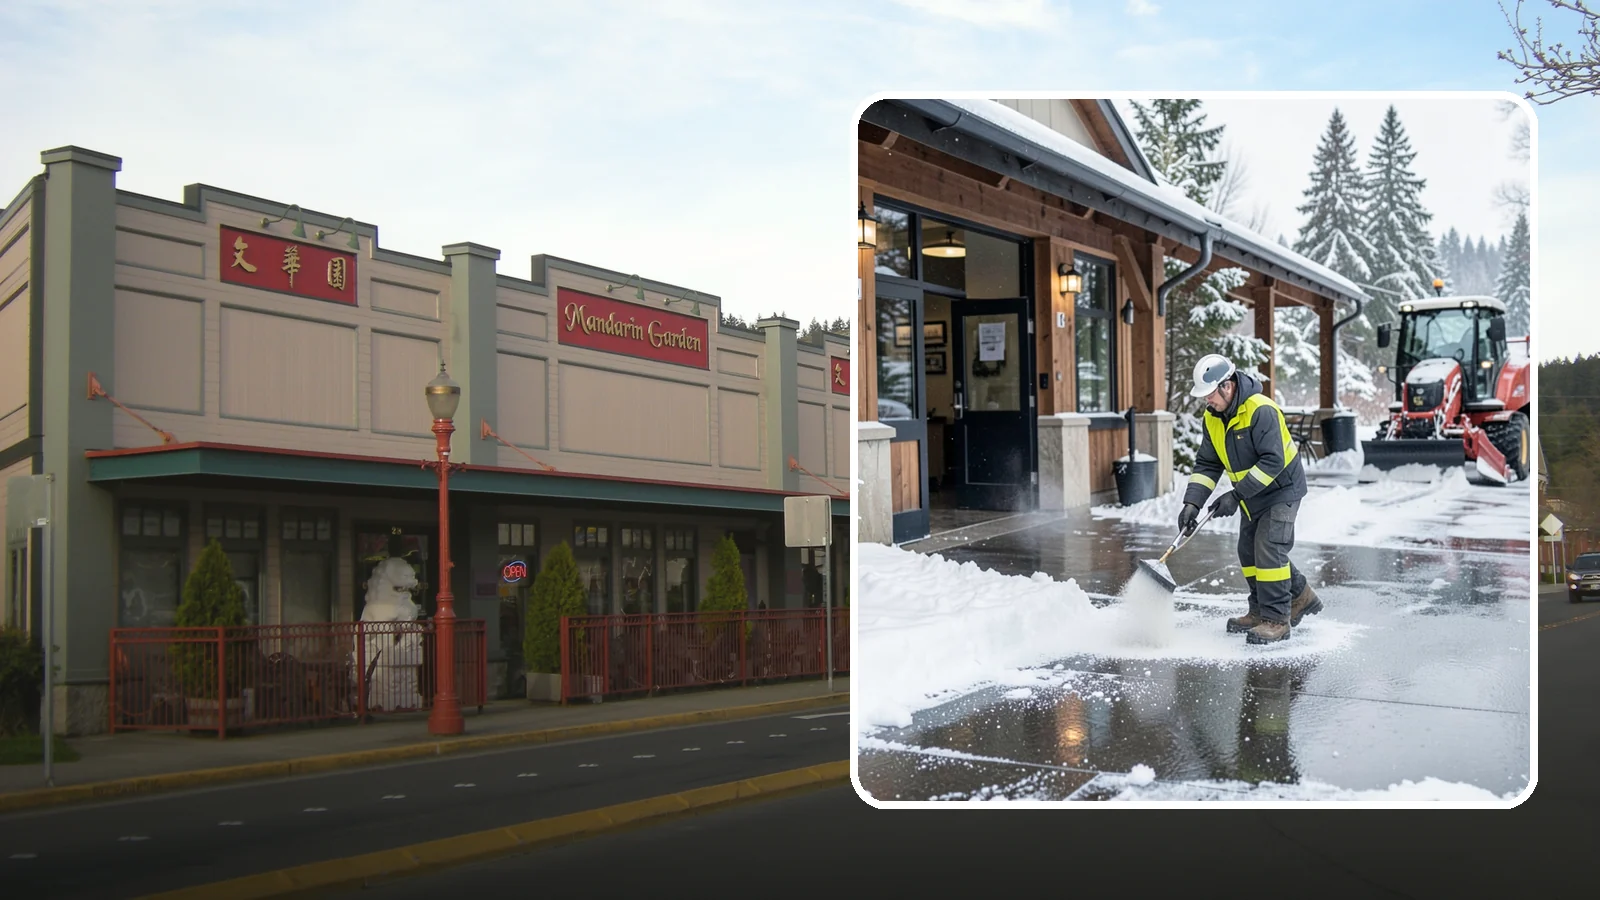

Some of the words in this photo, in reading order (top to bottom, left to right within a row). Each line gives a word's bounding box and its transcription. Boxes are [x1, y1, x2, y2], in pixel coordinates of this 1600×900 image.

[231, 235, 346, 291] 文華園
[564, 302, 644, 341] Mandarin
[647, 320, 702, 352] Garden
[503, 565, 527, 578] OPEN
